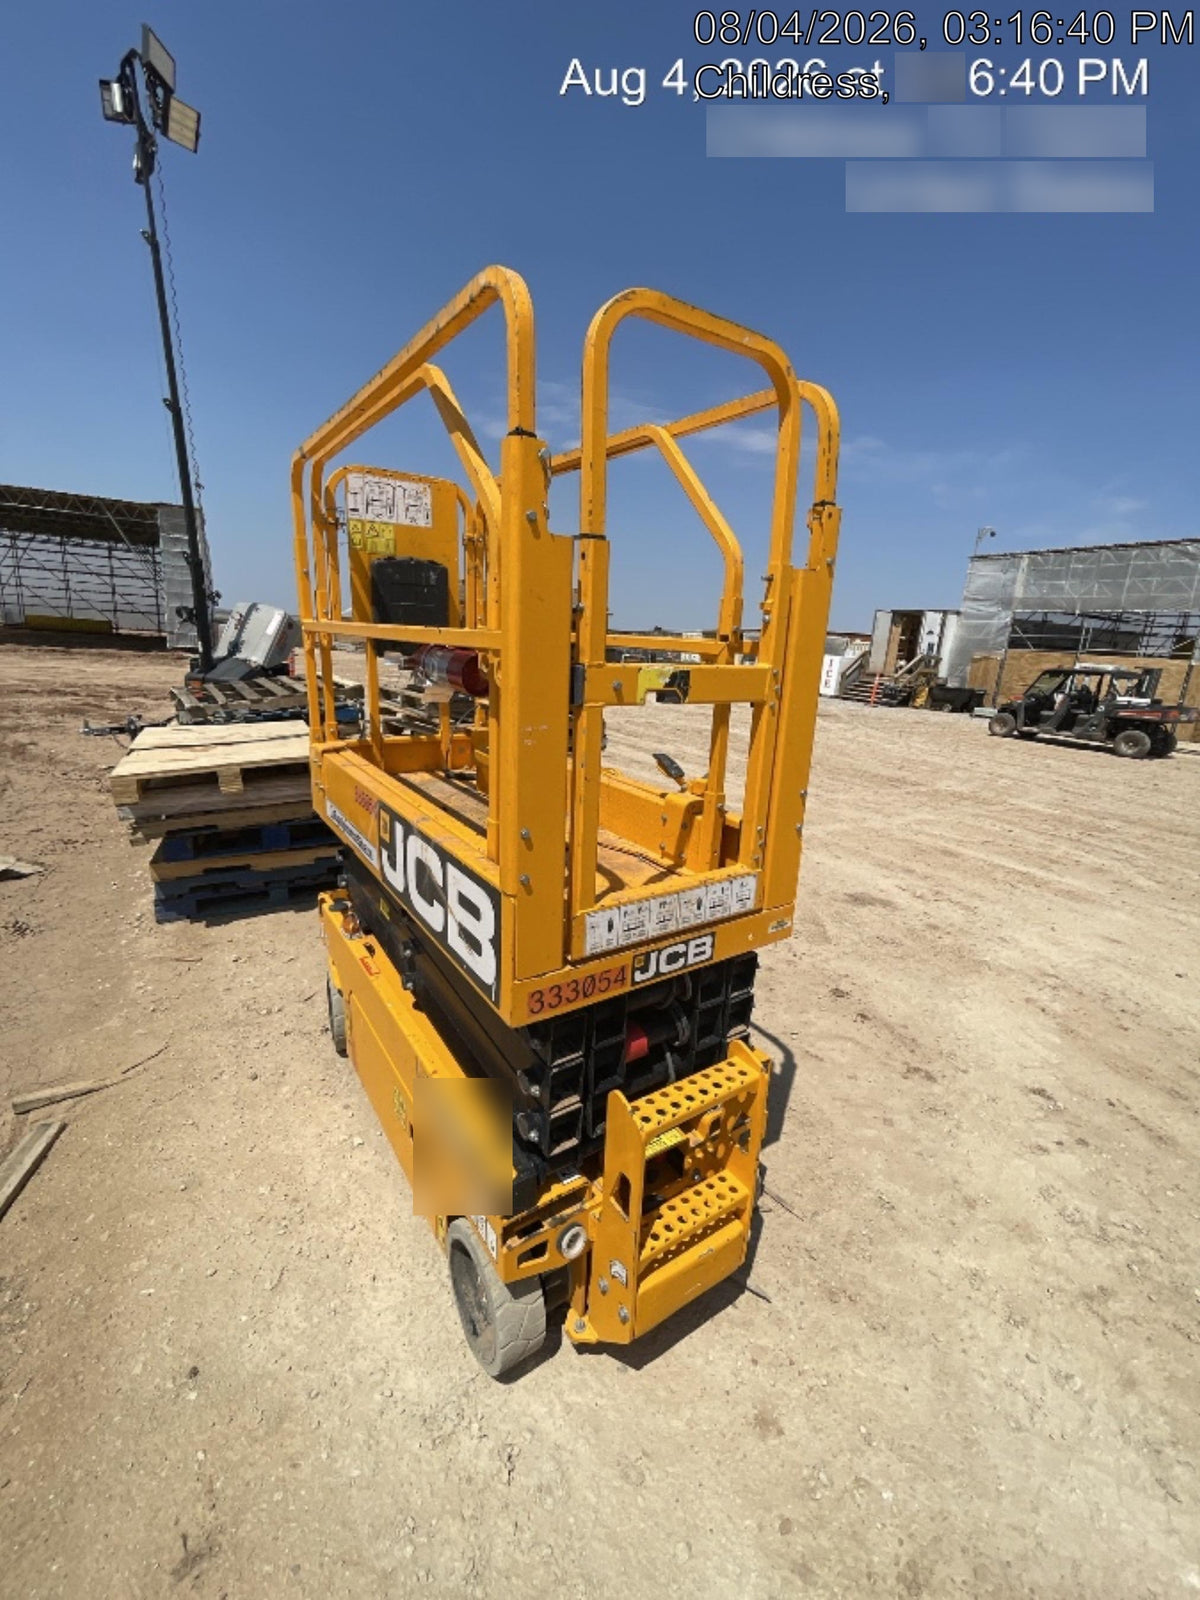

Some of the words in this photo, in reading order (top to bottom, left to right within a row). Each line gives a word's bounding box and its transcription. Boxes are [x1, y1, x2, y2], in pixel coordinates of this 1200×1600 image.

[381, 820, 497, 986] JCB
[633, 934, 714, 982] JCB
[528, 965, 627, 1015] 333054
